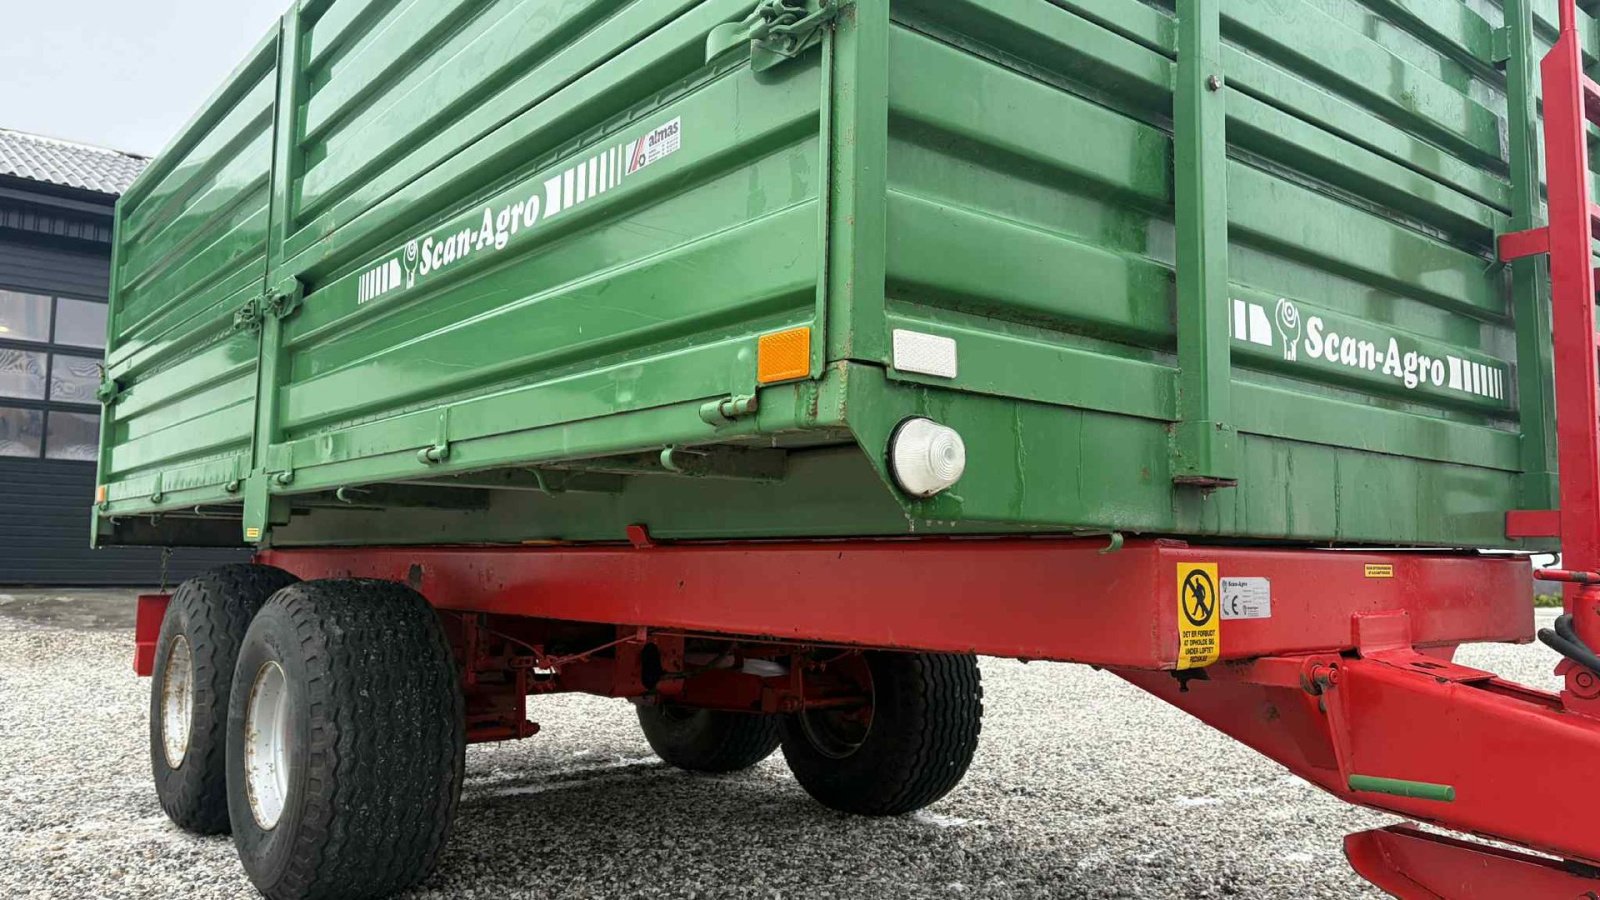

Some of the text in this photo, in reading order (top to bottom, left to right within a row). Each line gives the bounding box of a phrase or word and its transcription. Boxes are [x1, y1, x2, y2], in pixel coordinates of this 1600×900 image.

[648, 121, 679, 147] almas
[419, 194, 540, 276] Scan-Agro
[1304, 316, 1445, 389] Scan-Agro
